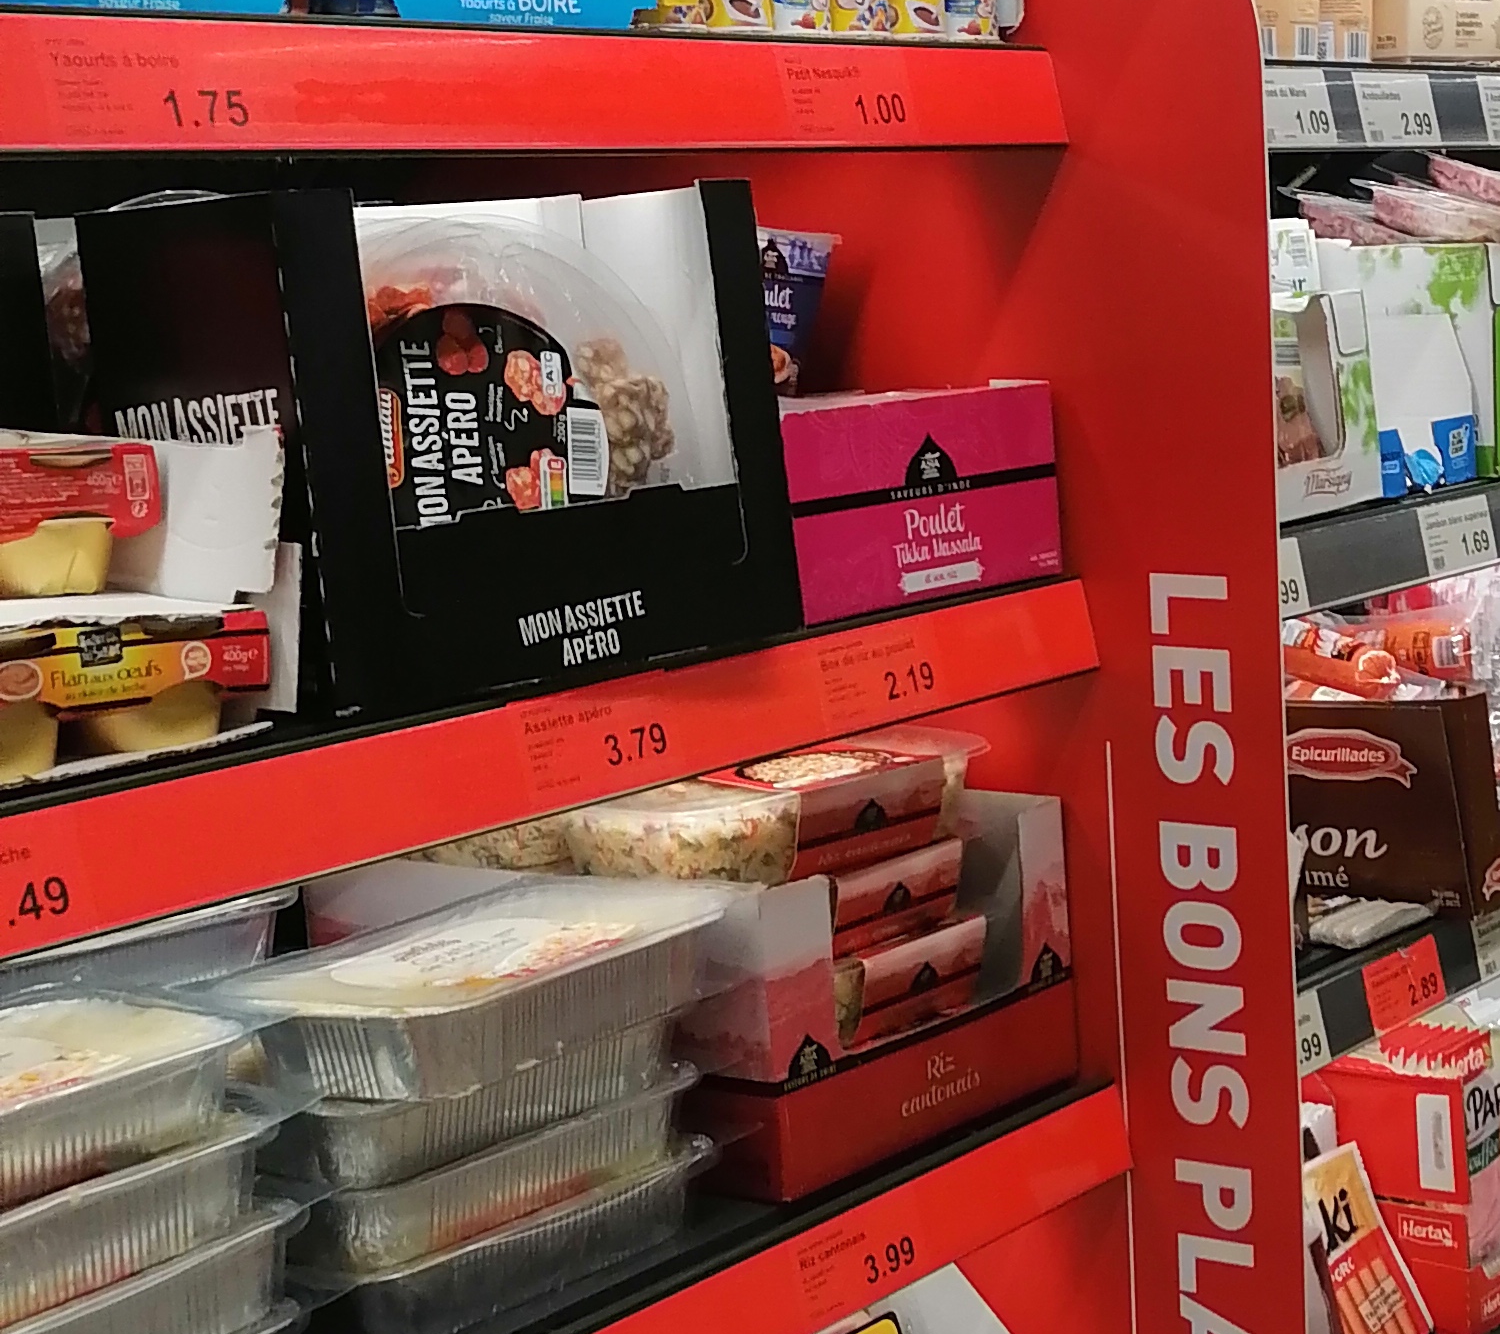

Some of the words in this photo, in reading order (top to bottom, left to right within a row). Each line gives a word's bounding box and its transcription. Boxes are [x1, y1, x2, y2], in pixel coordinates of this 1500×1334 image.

[50, 52, 117, 68] Yaourts
[162, 88, 250, 128] 1.75
[854, 92, 907, 126] 1.00
[1294, 109, 1331, 135] 1.09
[1399, 112, 1433, 137] 2.99
[114, 400, 171, 441] MON
[177, 388, 279, 445] ASSIETTE
[399, 339, 446, 472] ASSIETTE
[443, 391, 484, 487] APÉRO
[903, 500, 967, 540] Poulet
[892, 542, 932, 569] Tikka
[1461, 528, 1490, 557] 1.69
[518, 608, 561, 647] MON
[559, 589, 647, 634] ASSIETTE
[561, 627, 621, 668] APÉRO
[50, 668, 89, 691] Flan
[883, 660, 936, 703] 2.19
[1147, 569, 1236, 789] LES
[523, 712, 576, 737] Assiette
[578, 703, 614, 727] apéro
[603, 721, 669, 768] 3.79
[1291, 745, 1386, 765] Epicurillades
[1157, 819, 1252, 1132] BONS
[1407, 971, 1439, 1007] 2.89
[926, 1050, 956, 1081] Riz
[901, 1066, 982, 1118] cantonais
[1401, 1218, 1453, 1248] Herta
[863, 1235, 916, 1285] 3.99
